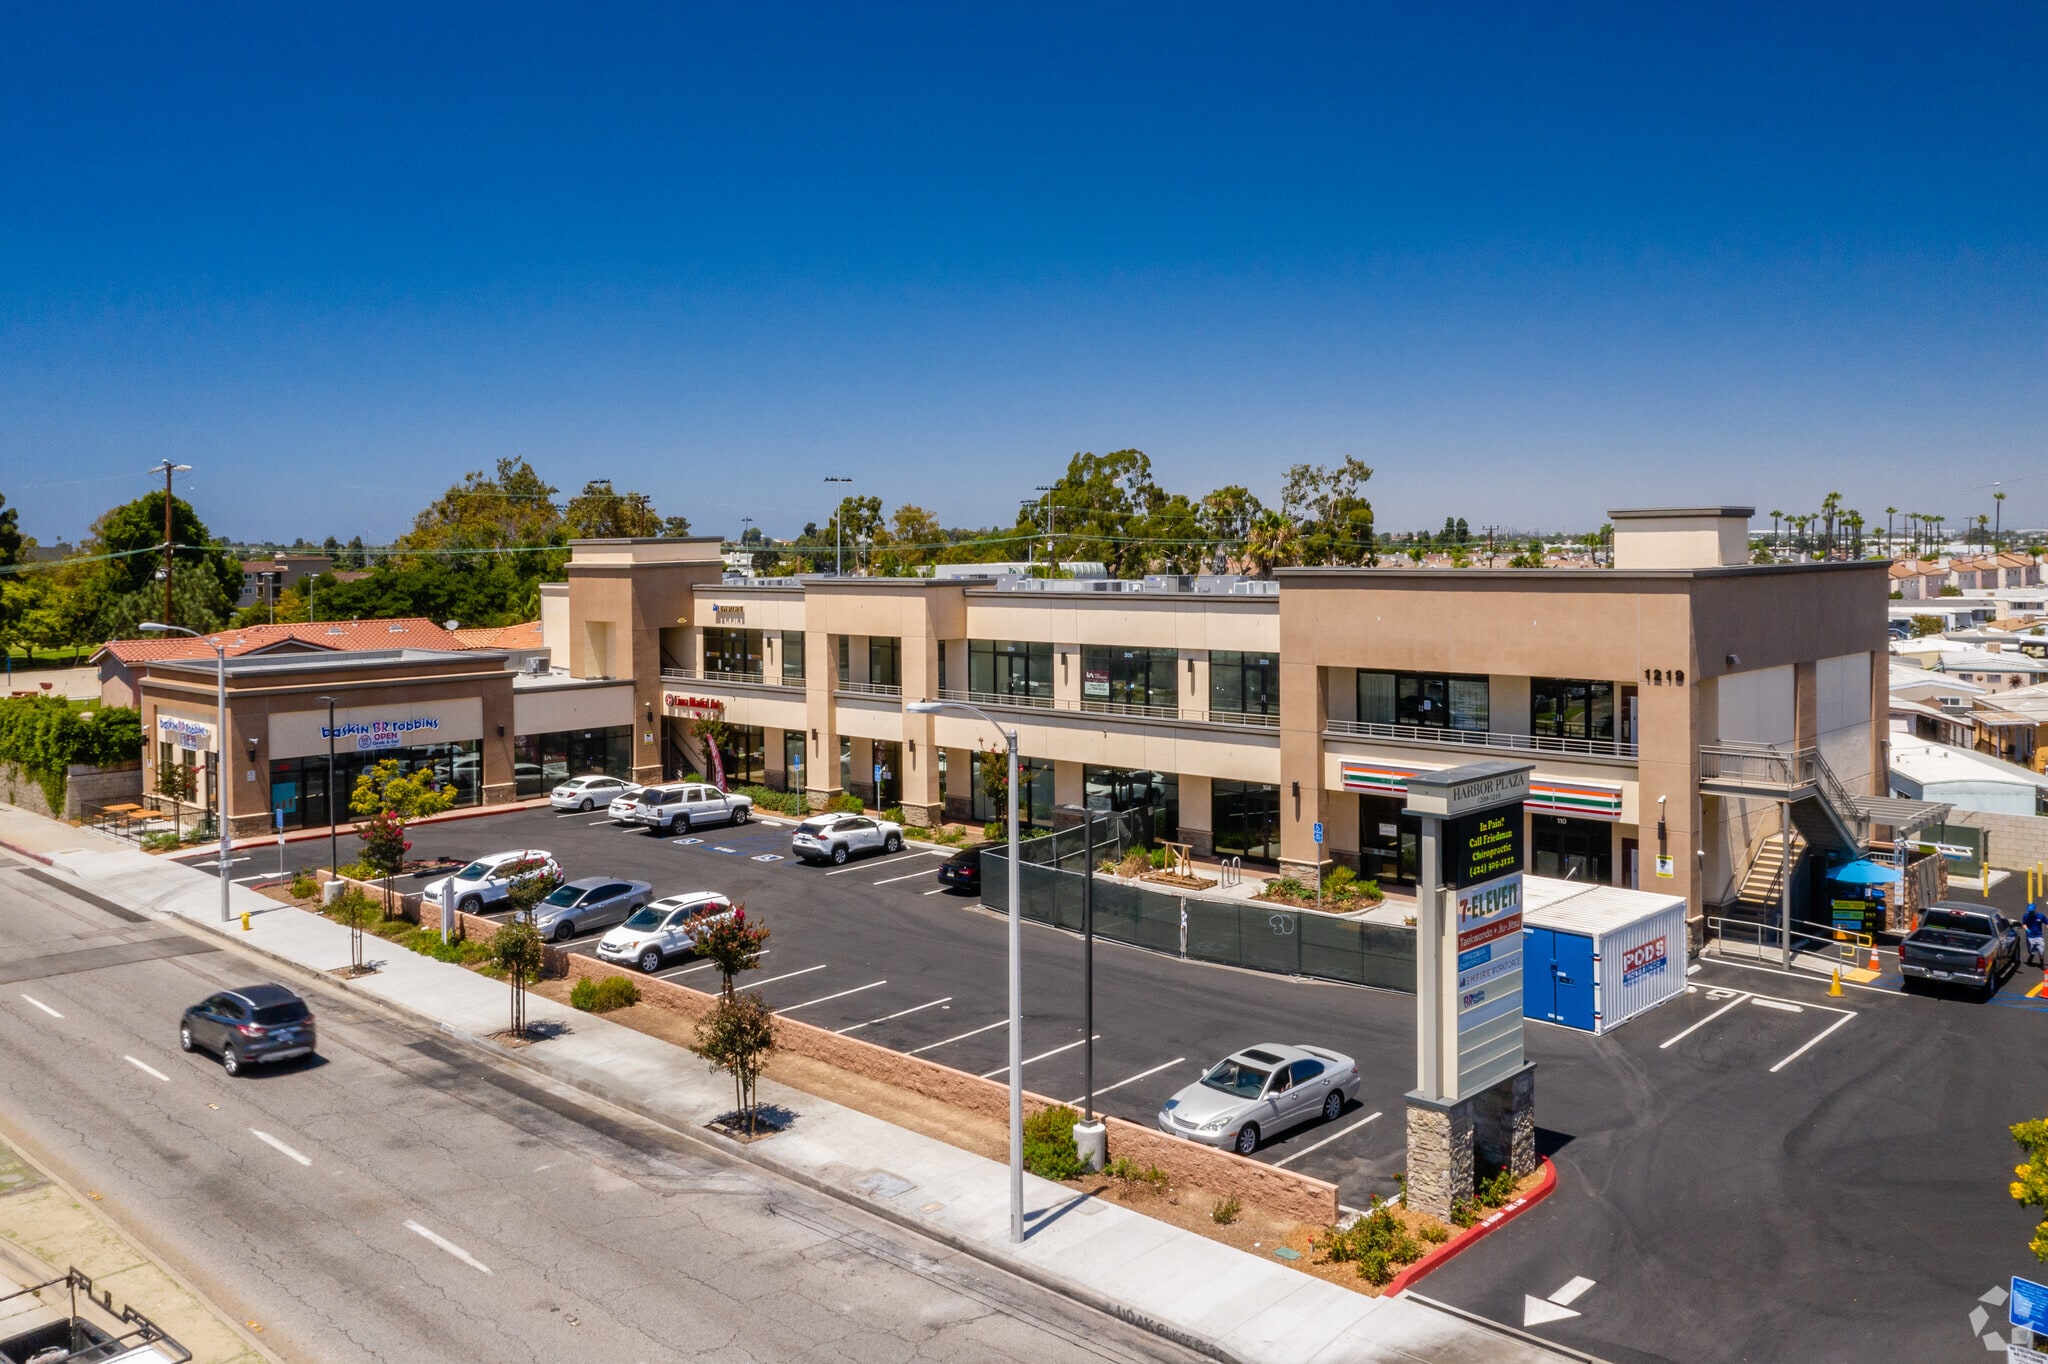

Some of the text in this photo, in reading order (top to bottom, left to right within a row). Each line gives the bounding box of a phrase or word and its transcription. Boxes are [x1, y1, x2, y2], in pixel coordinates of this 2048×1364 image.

[1644, 668, 1685, 687] 1219
[320, 723, 370, 738] baskin
[392, 717, 439, 732] robbins
[373, 732, 398, 741] OPEN
[1453, 773, 1525, 801] HARBOR PLAZA
[1480, 817, 1505, 832] In Pain?
[1469, 830, 1513, 848] Call Friedman
[1472, 843, 1512, 861] Chiropractic
[1460, 920, 1520, 948] Taekwondo Jiu-Jitsu
[1623, 940, 1665, 973] PODS
[1466, 956, 1521, 986] EMPIRE WORKFORCE
